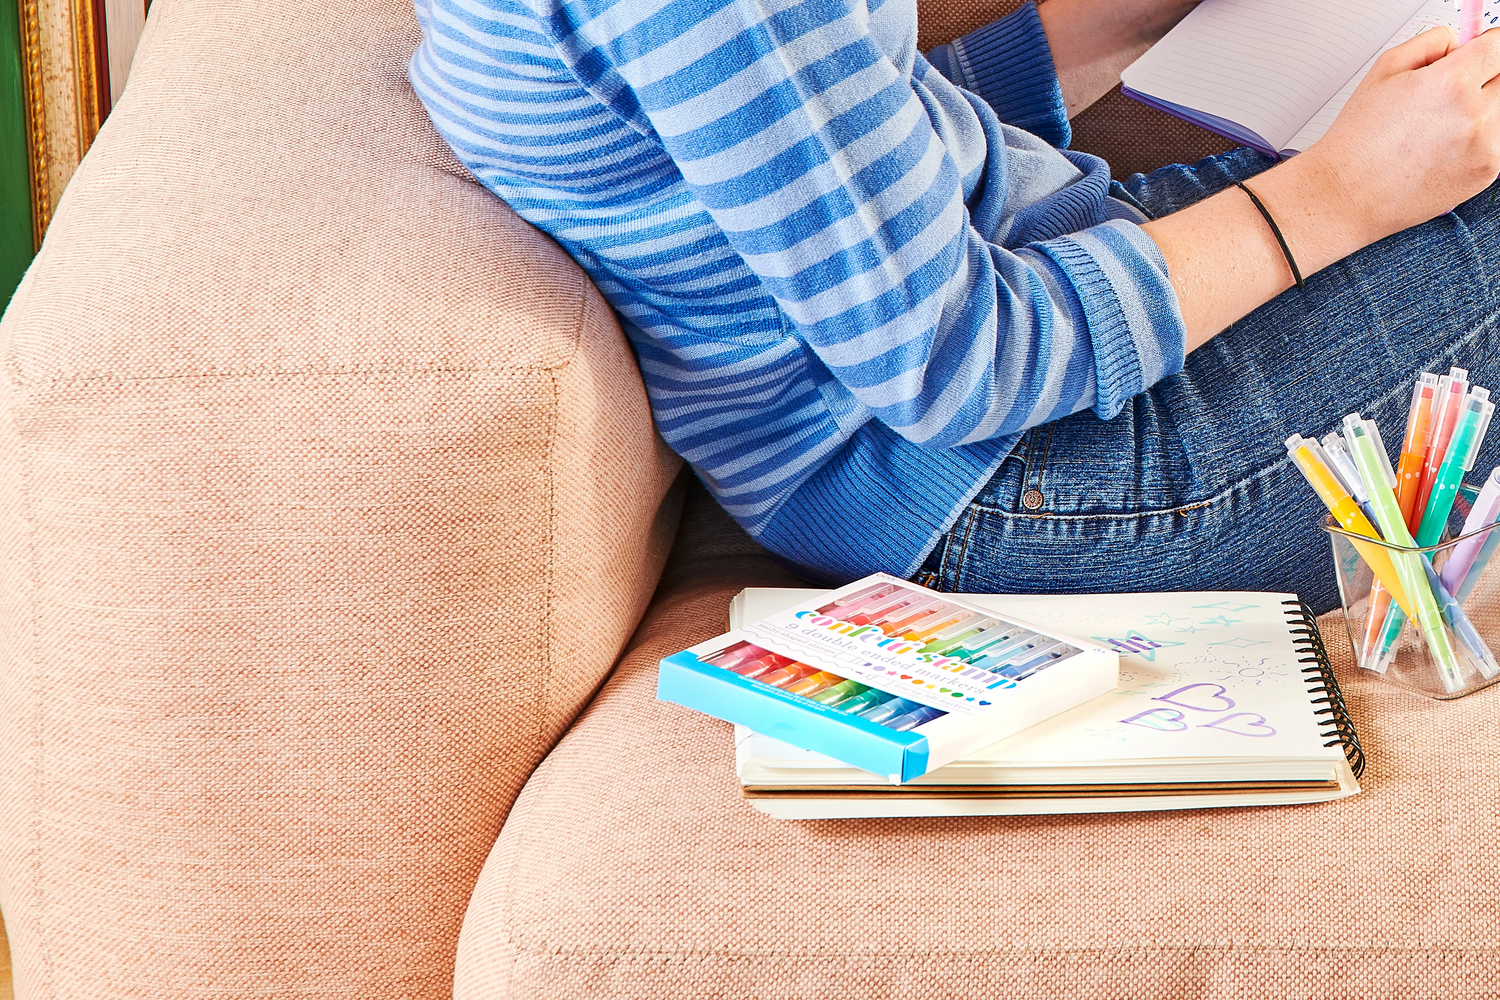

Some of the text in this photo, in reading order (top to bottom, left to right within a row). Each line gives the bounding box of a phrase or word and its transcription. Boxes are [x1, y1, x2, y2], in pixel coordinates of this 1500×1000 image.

[795, 611, 1017, 690] confetti stamp
[801, 628, 858, 651] double
[861, 650, 916, 670] ended
[914, 668, 985, 695] markers
[808, 640, 837, 655] stamps
